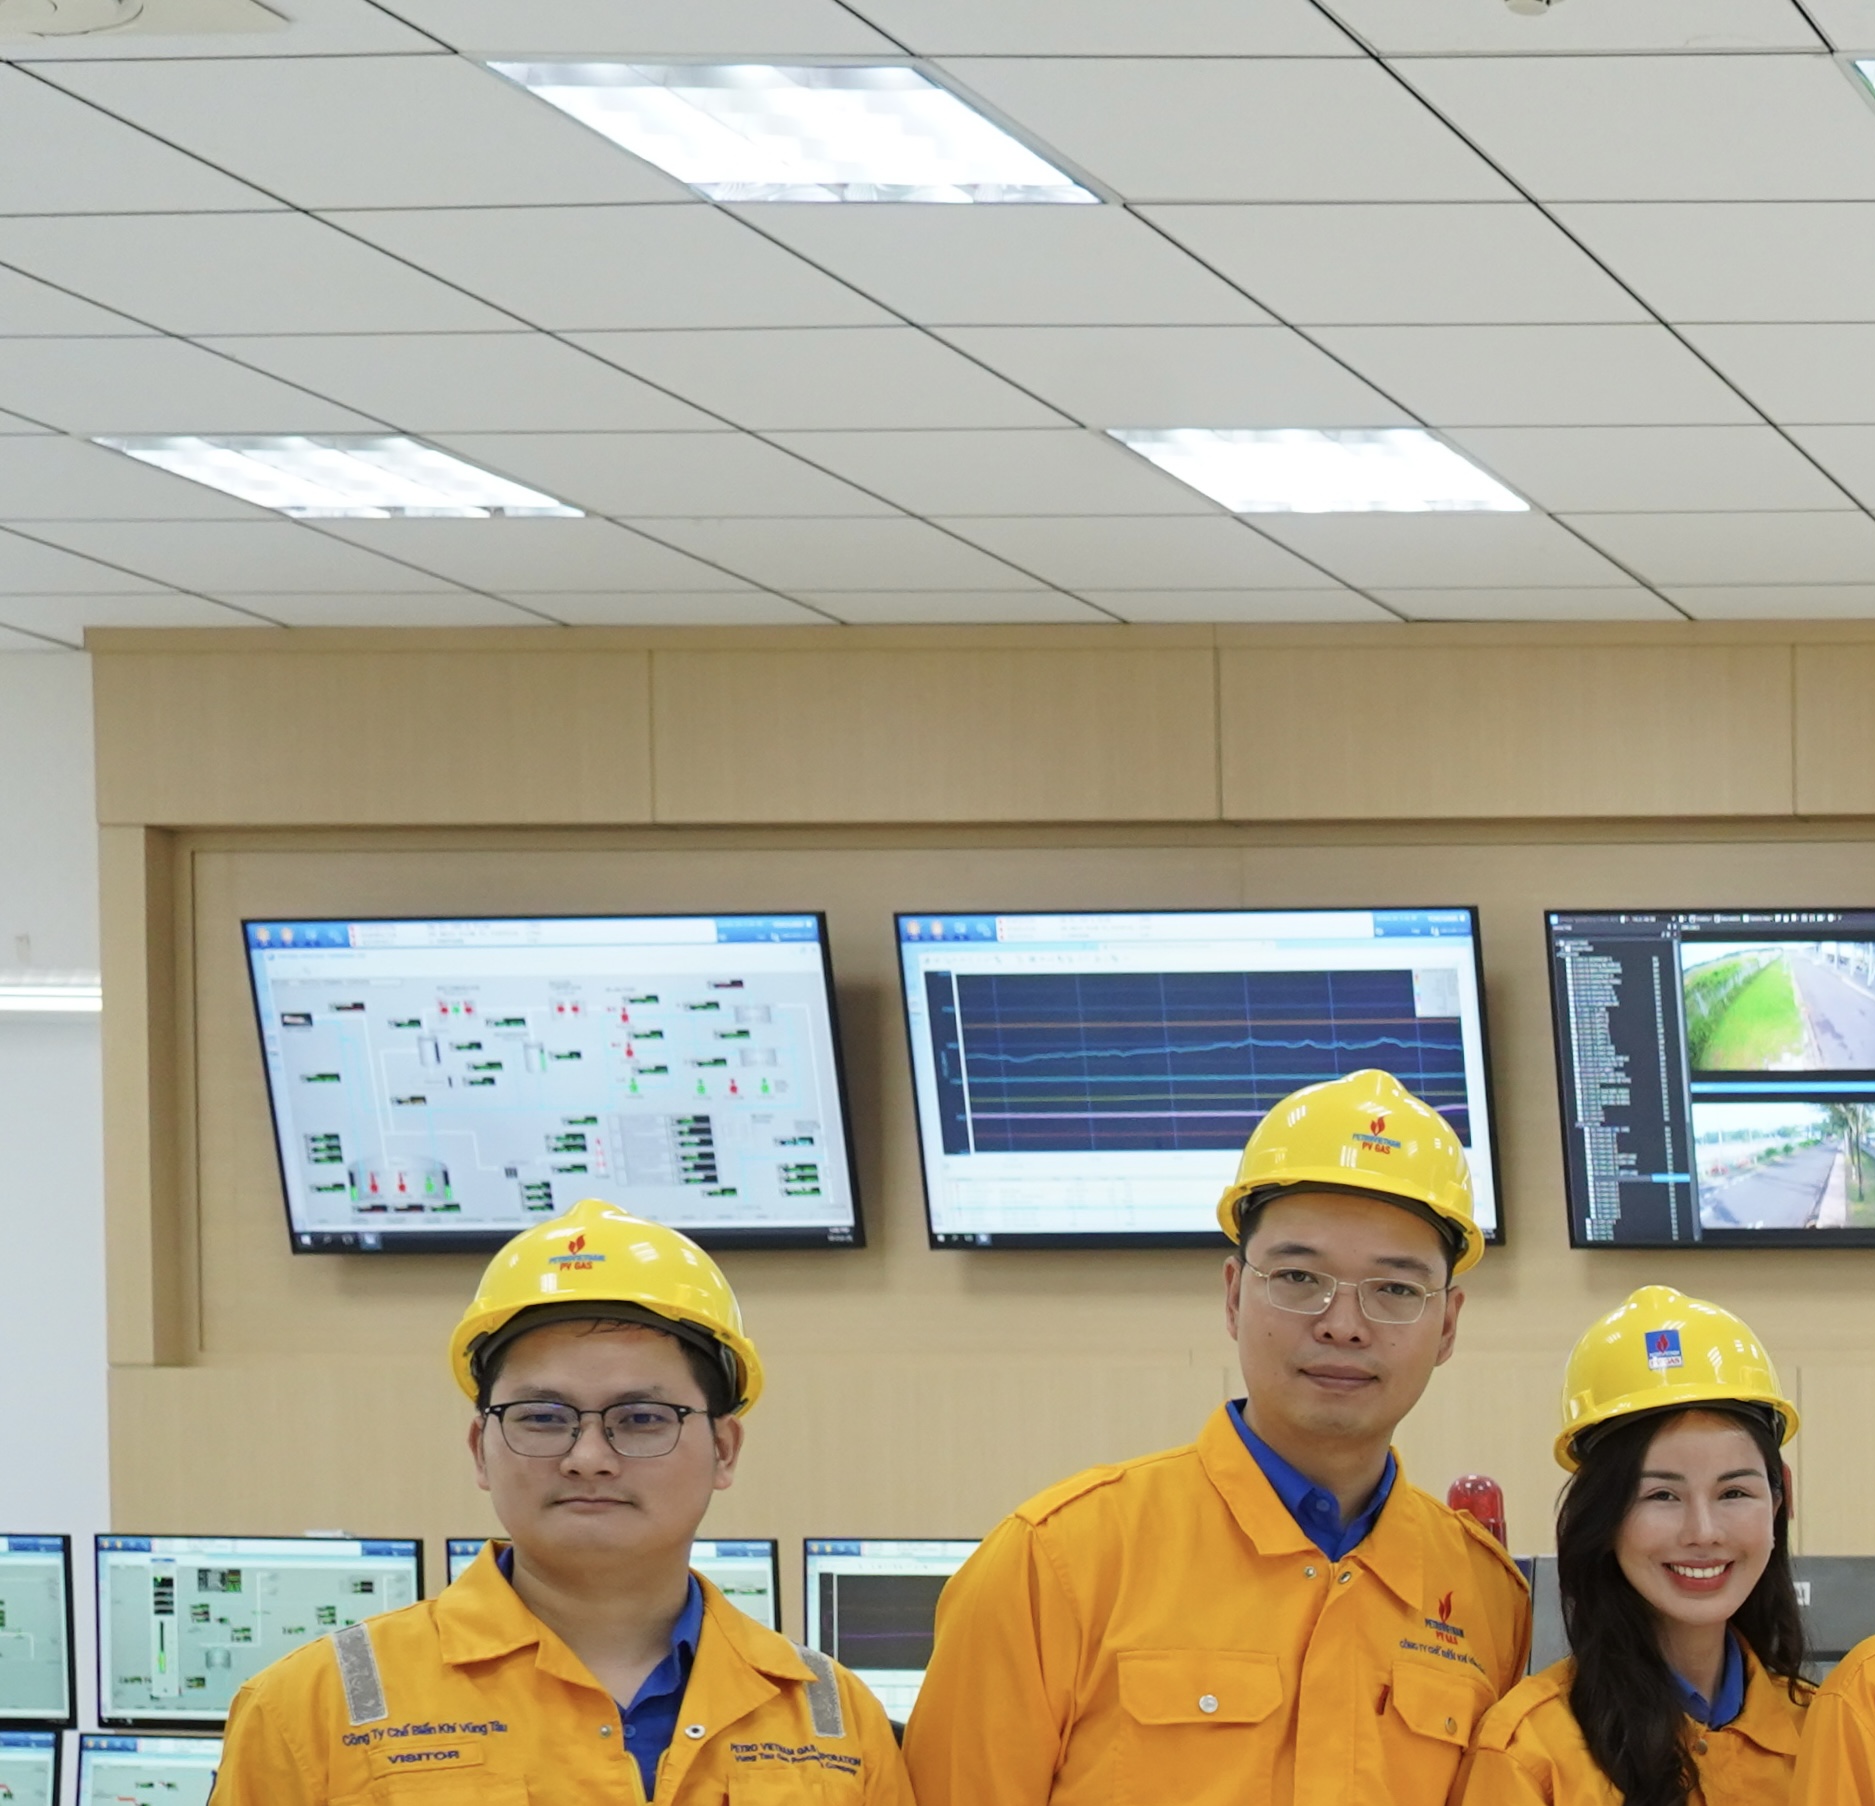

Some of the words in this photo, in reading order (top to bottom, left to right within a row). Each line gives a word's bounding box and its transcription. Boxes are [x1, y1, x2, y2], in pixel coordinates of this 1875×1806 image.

[1361, 1141, 1374, 1151] PV
[1374, 1143, 1391, 1155] GAS
[560, 1262, 572, 1271] PV
[574, 1261, 593, 1271] GAS
[342, 1732, 370, 1746] Công
[371, 1729, 386, 1741] Ty
[387, 1723, 411, 1737] Chế
[438, 1722, 457, 1734] Khí
[459, 1722, 488, 1736] Vũng
[730, 1743, 758, 1754] PETRO
[387, 1750, 460, 1764] VISITOR
